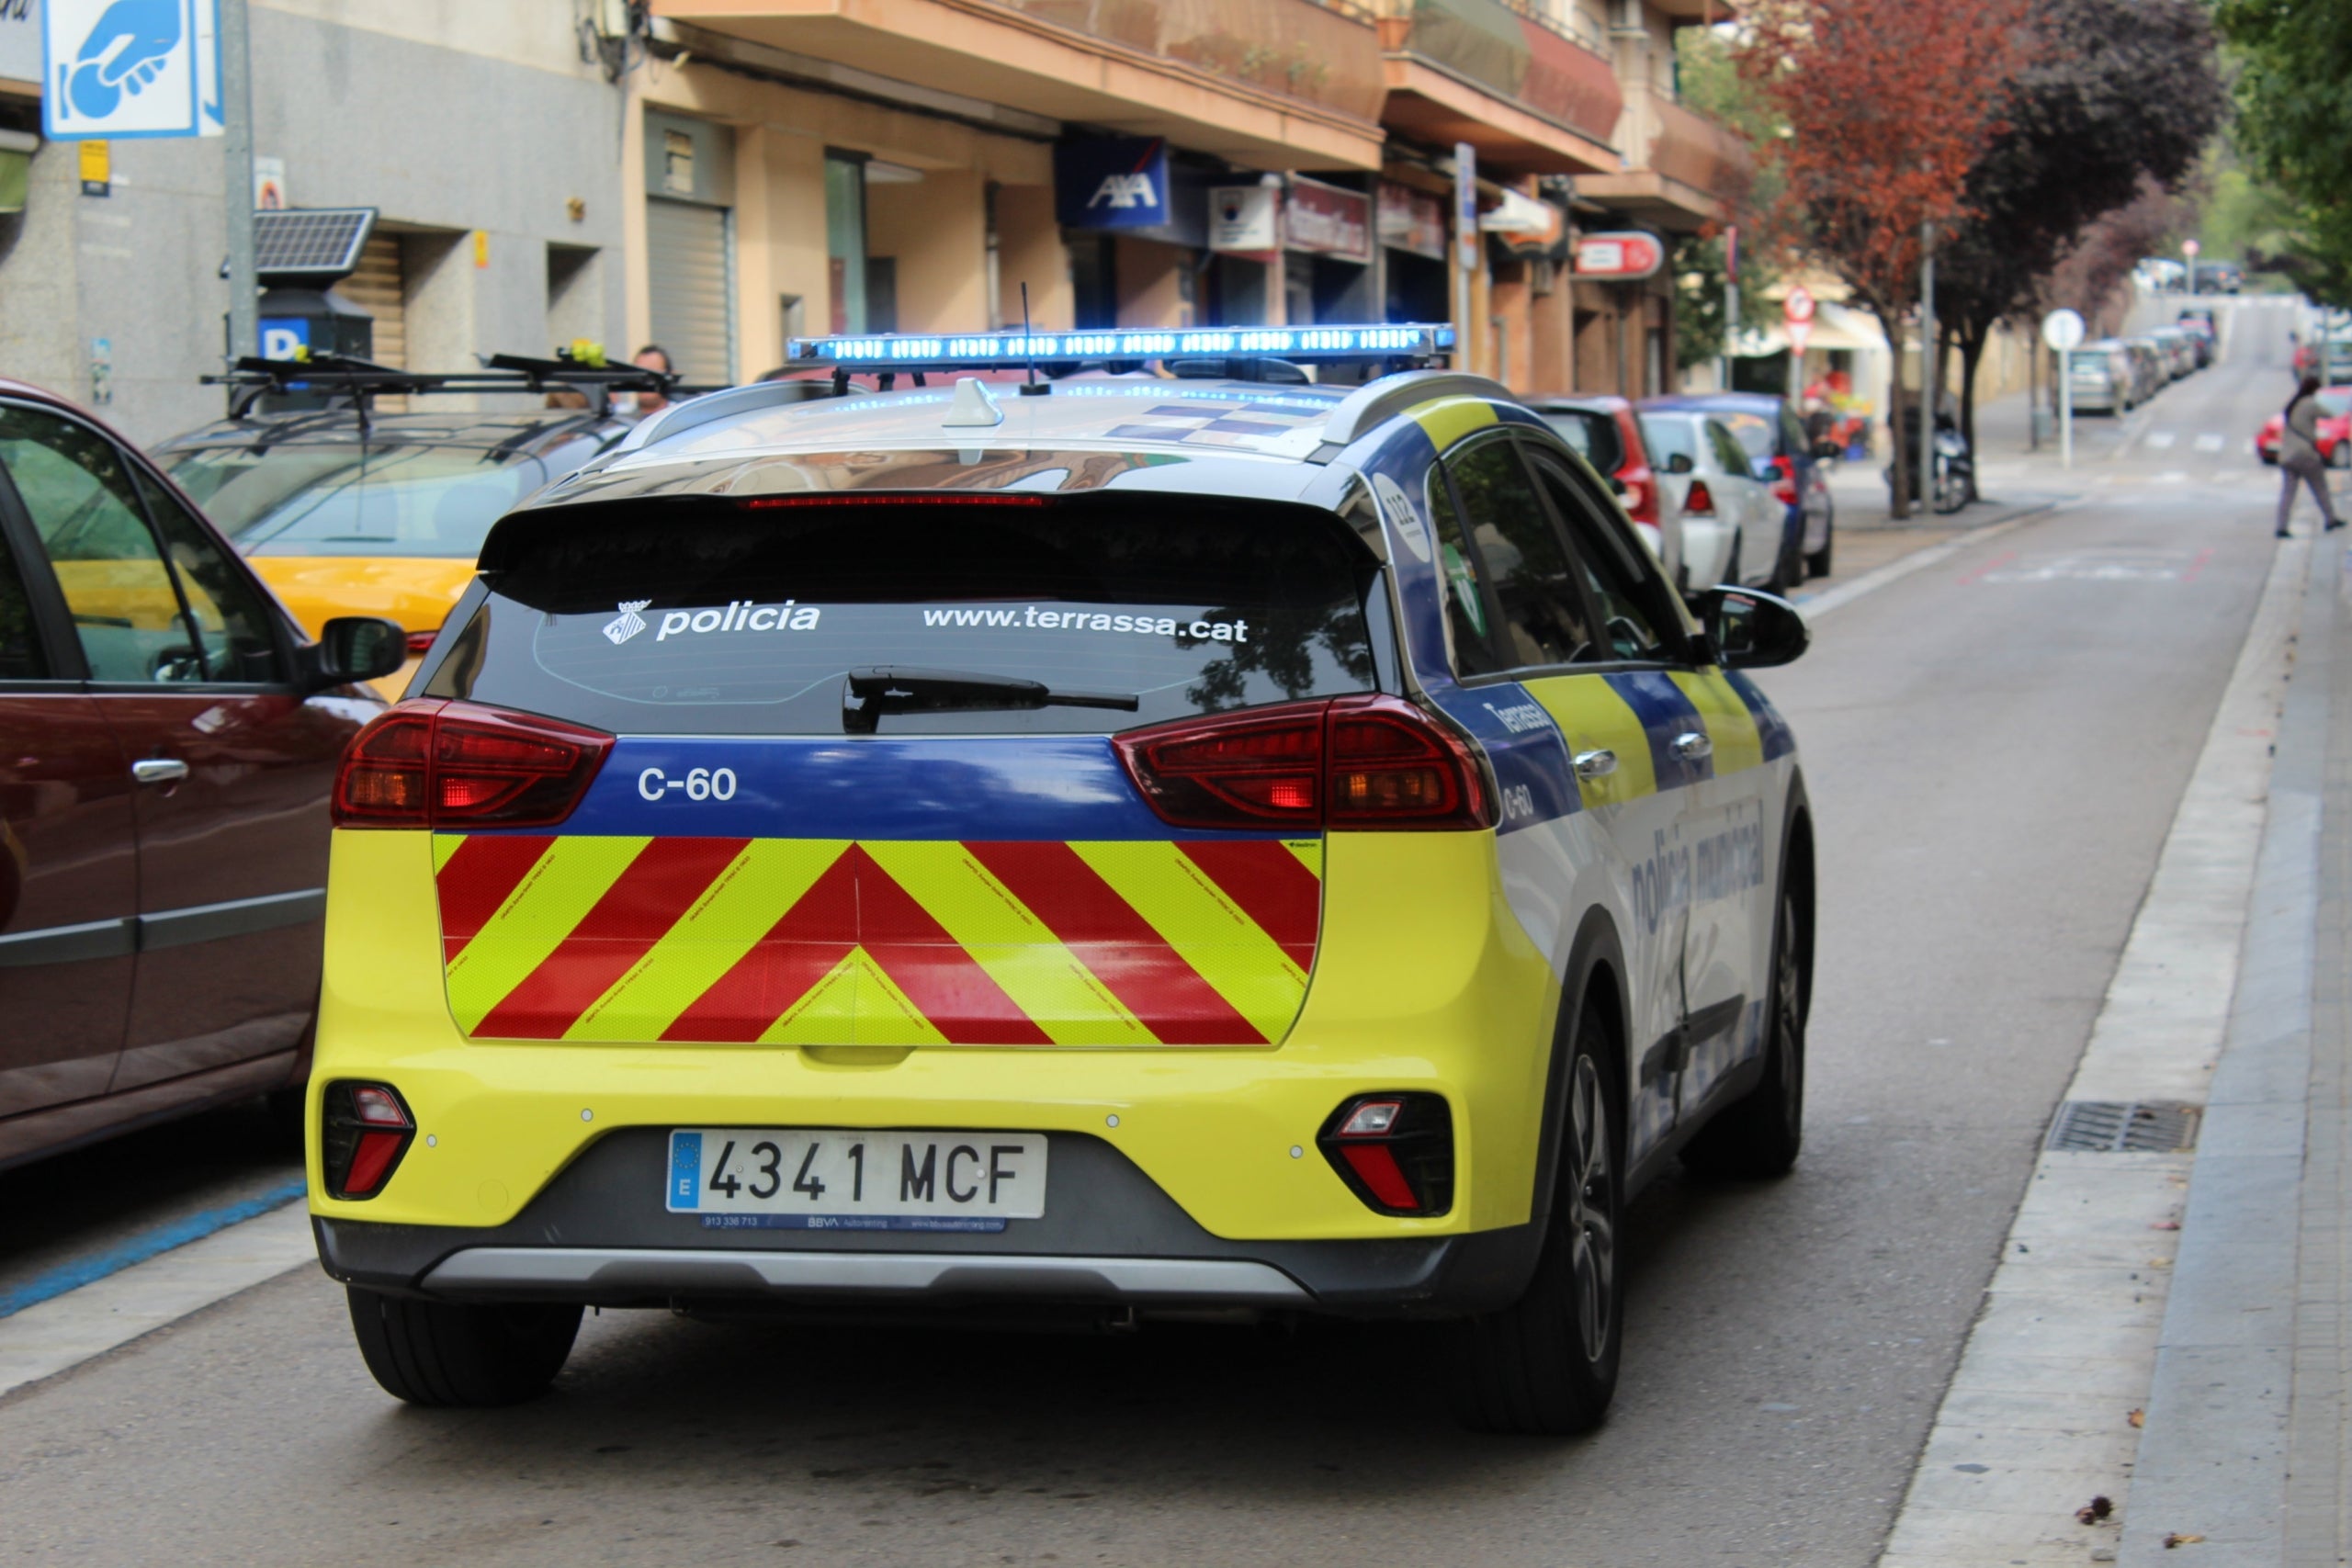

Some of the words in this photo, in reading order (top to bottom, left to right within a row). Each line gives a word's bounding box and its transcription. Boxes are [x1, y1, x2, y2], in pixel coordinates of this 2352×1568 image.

[1087, 173, 1158, 208] AXA
[656, 599, 820, 642] policia
[923, 605, 1249, 643] www.terrassa.cat
[1482, 703, 1553, 734] Terrassa
[638, 767, 737, 802] C-60
[1503, 784, 1534, 820] C-60
[678, 1178, 692, 1196] E
[708, 1140, 865, 1202] 4341
[899, 1143, 1024, 1204] MCF
[808, 1217, 840, 1228] BBVA
